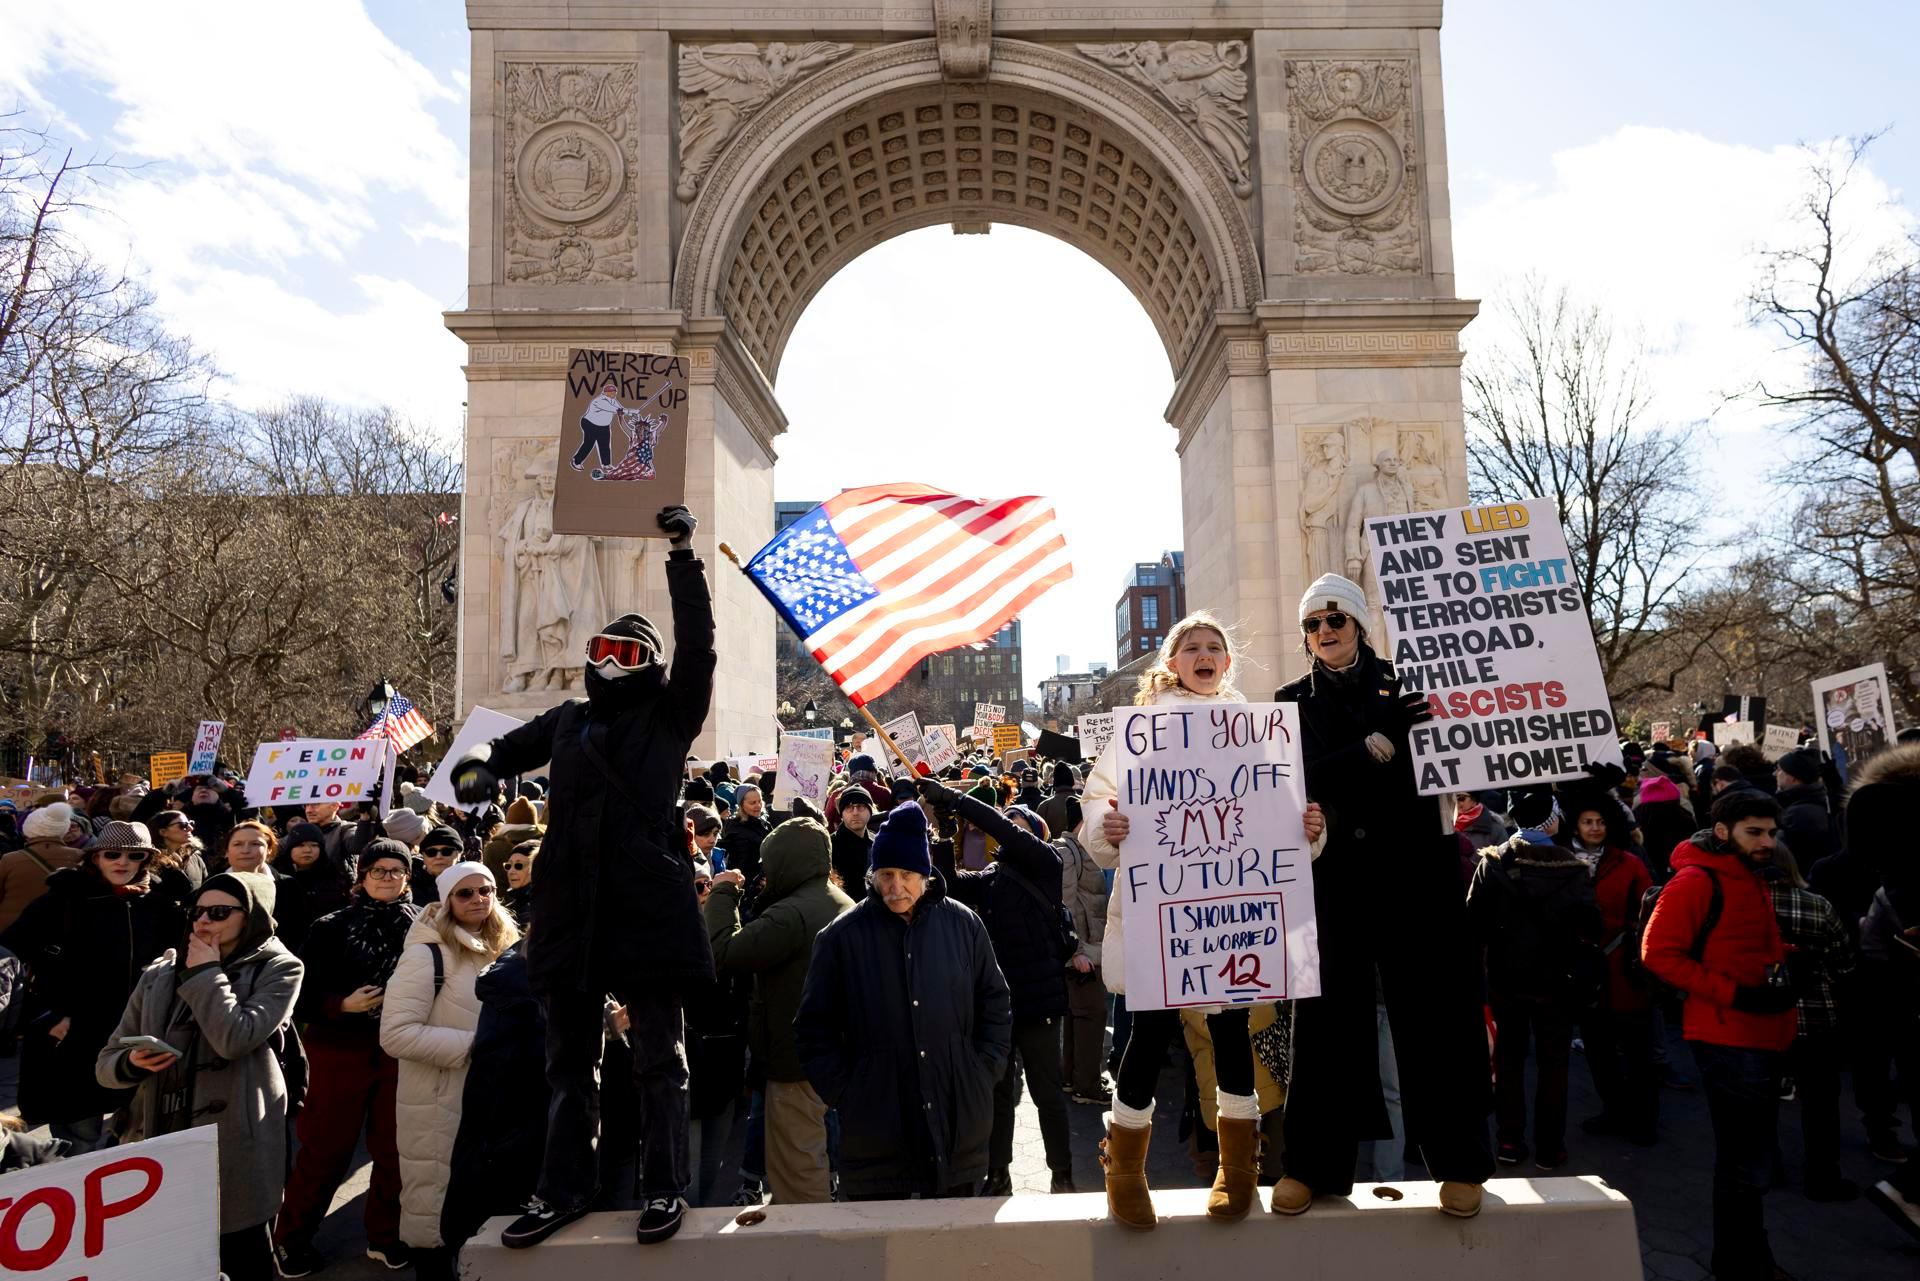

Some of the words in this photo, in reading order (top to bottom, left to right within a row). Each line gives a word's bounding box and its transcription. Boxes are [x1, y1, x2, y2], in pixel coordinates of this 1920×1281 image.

[743, 9, 813, 19] ERECTED
[818, 9, 834, 19] BY
[845, 9, 871, 19] THE
[878, 9, 930, 19] PEOPLE
[997, 9, 1011, 19] OF
[1021, 9, 1044, 19] THE
[1050, 9, 1083, 19] CITY
[1090, 9, 1104, 18] OF
[1112, 9, 1144, 18] NEW
[1153, 8, 1189, 18] YORK
[570, 349, 687, 379] AMERICA.
[568, 372, 650, 400] WAKE
[659, 388, 687, 409] UP
[1370, 515, 1446, 547] THEY
[1461, 503, 1530, 534] LIED
[1379, 545, 1443, 576] AND
[1455, 534, 1531, 566] SENT
[1383, 576, 1429, 604] ME
[1433, 570, 1477, 597] TO
[1479, 558, 1567, 593] FIGHT
[1395, 623, 1544, 665] ABROAD,
[1397, 656, 1499, 693] WHILE
[988, 713, 1004, 722] BODY
[1410, 680, 1567, 721] ASCISTS
[203, 724, 221, 736] TAX
[974, 727, 993, 736] DECIS
[1084, 727, 1097, 735] WE
[1086, 717, 1113, 726] REME
[1125, 712, 1194, 755] GET
[1211, 708, 1290, 749] YOUR
[1412, 709, 1612, 756] FLOURISHED
[198, 741, 218, 751] RICH
[930, 746, 955, 768] RANNY
[272, 769, 309, 780] AND
[318, 767, 347, 776] THE
[1127, 768, 1216, 805] HANDS
[1231, 764, 1291, 798] OFF
[1419, 758, 1461, 790] AT
[1484, 743, 1587, 782] HOME!
[271, 783, 362, 800] FELON
[1181, 805, 1230, 845] MY
[1129, 848, 1300, 902] FUTURE
[1169, 907, 1176, 933] I
[1183, 901, 1279, 932] SHOULDN'T
[1170, 938, 1193, 958] BE
[1203, 926, 1278, 954] WORRIED
[1182, 965, 1213, 995] AT
[1218, 954, 1271, 988] 12
